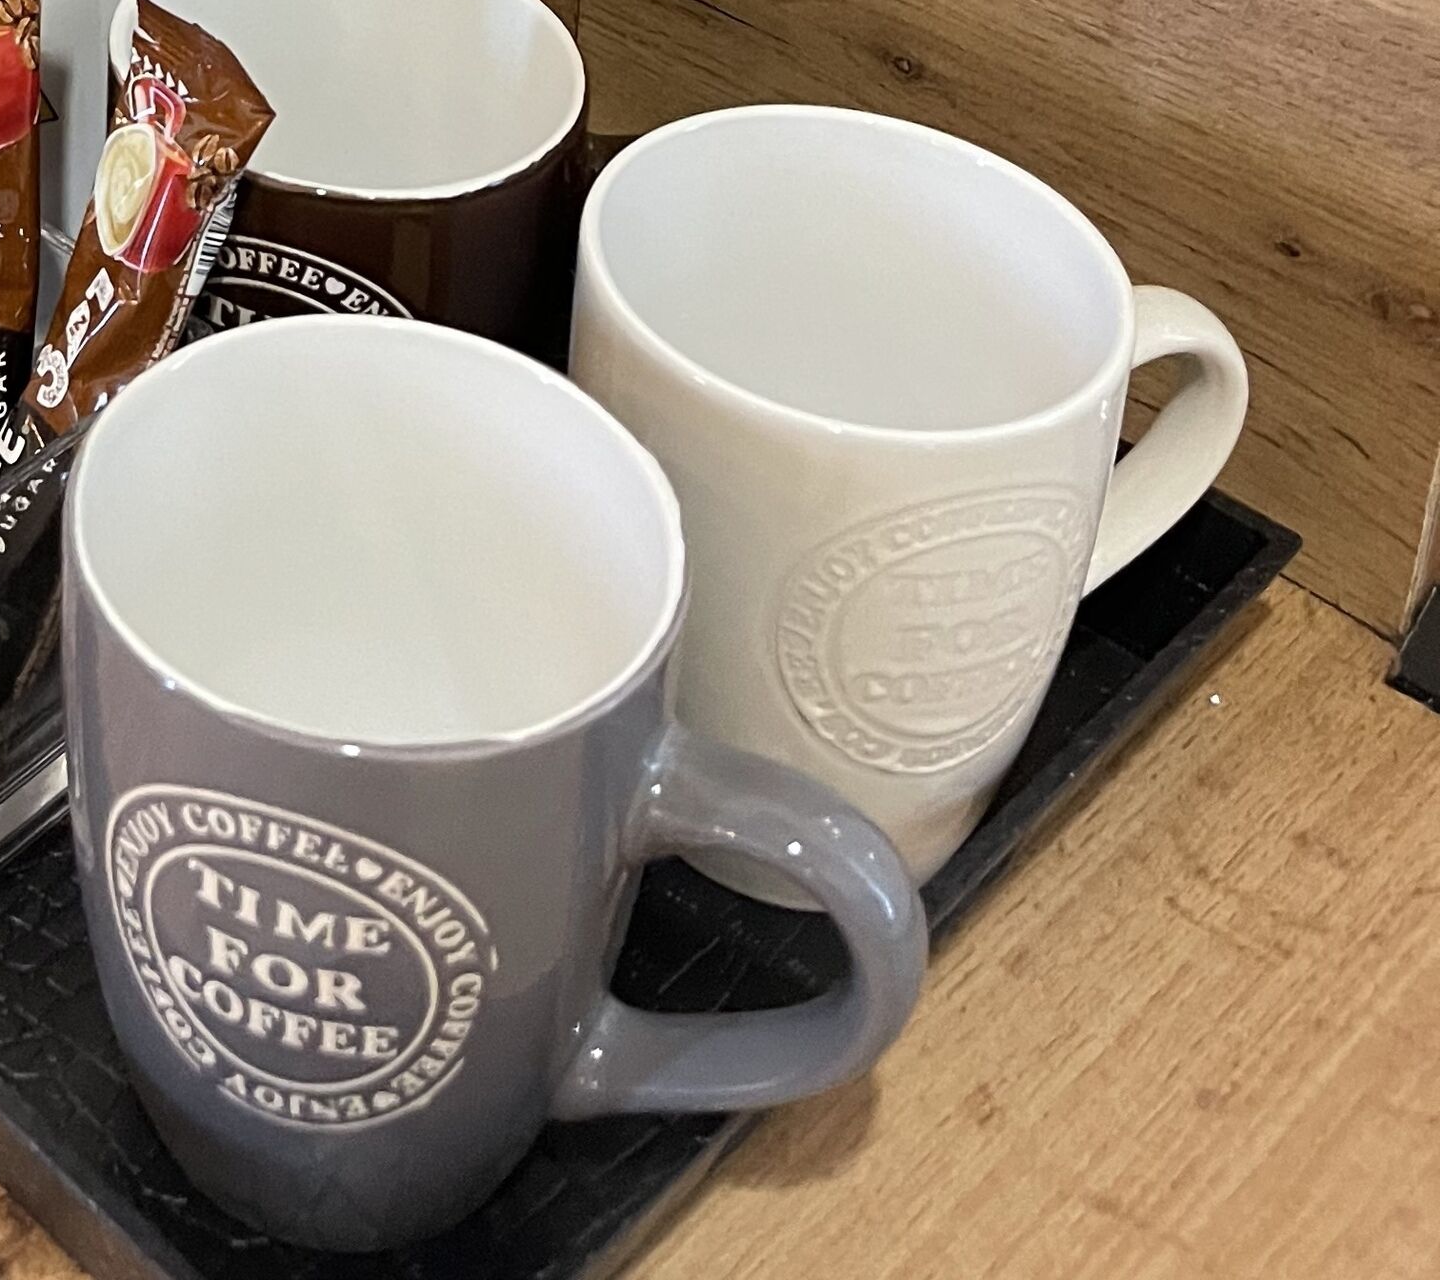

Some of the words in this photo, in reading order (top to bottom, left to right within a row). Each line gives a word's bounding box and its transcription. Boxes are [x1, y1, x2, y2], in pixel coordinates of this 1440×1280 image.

[216, 245, 325, 291] OFFEE
[181, 802, 350, 874] COFFEE
[377, 869, 477, 965] ENJOY
[187, 856, 392, 955] TIME
[167, 954, 400, 1058] COFFEE
[205, 924, 367, 1011] FOR
